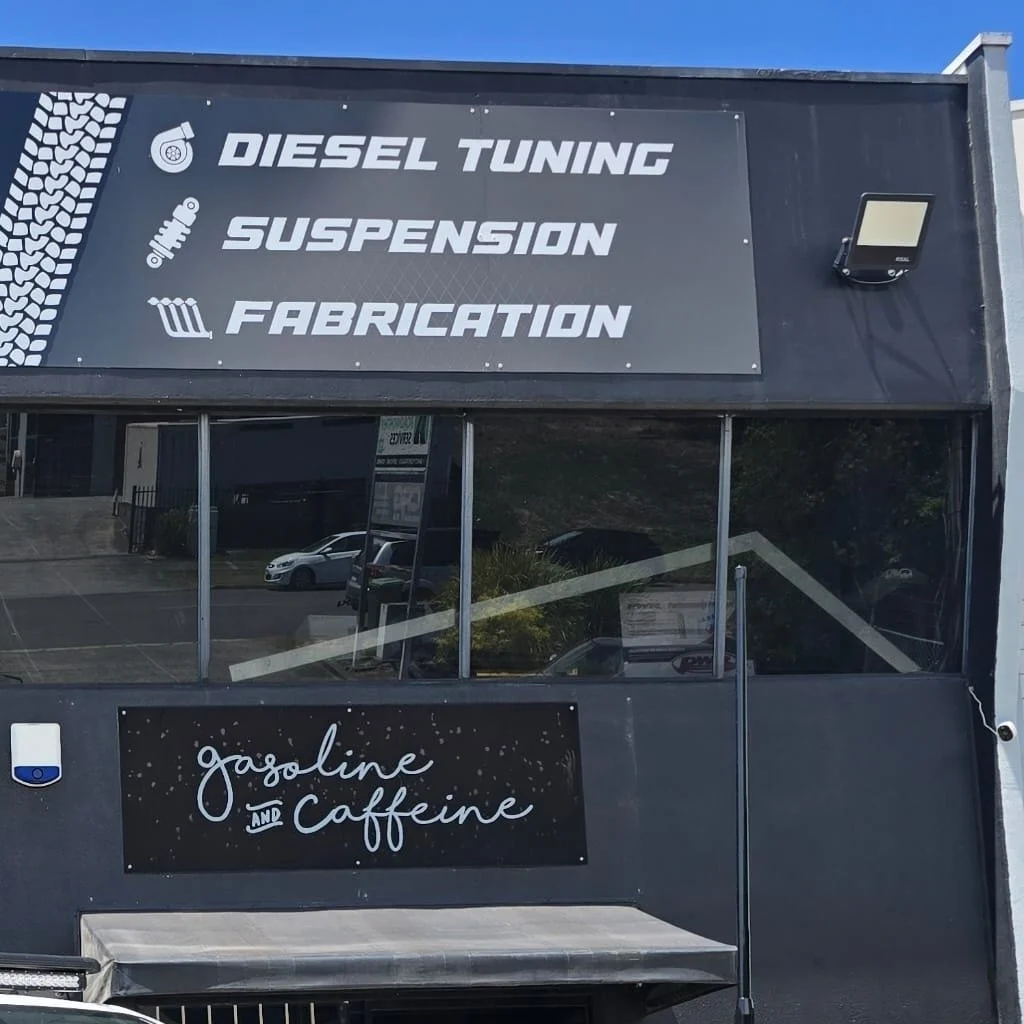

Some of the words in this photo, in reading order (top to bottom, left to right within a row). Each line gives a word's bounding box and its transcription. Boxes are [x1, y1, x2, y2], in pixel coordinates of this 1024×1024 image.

[218, 133, 439, 170] DIESEL
[457, 138, 674, 176] TUNING
[221, 216, 617, 256] SUSPENSION
[225, 300, 632, 339] FABRICATION
[196, 722, 435, 822] gasoline
[249, 806, 283, 830] AND
[292, 786, 534, 854] Caffeine
